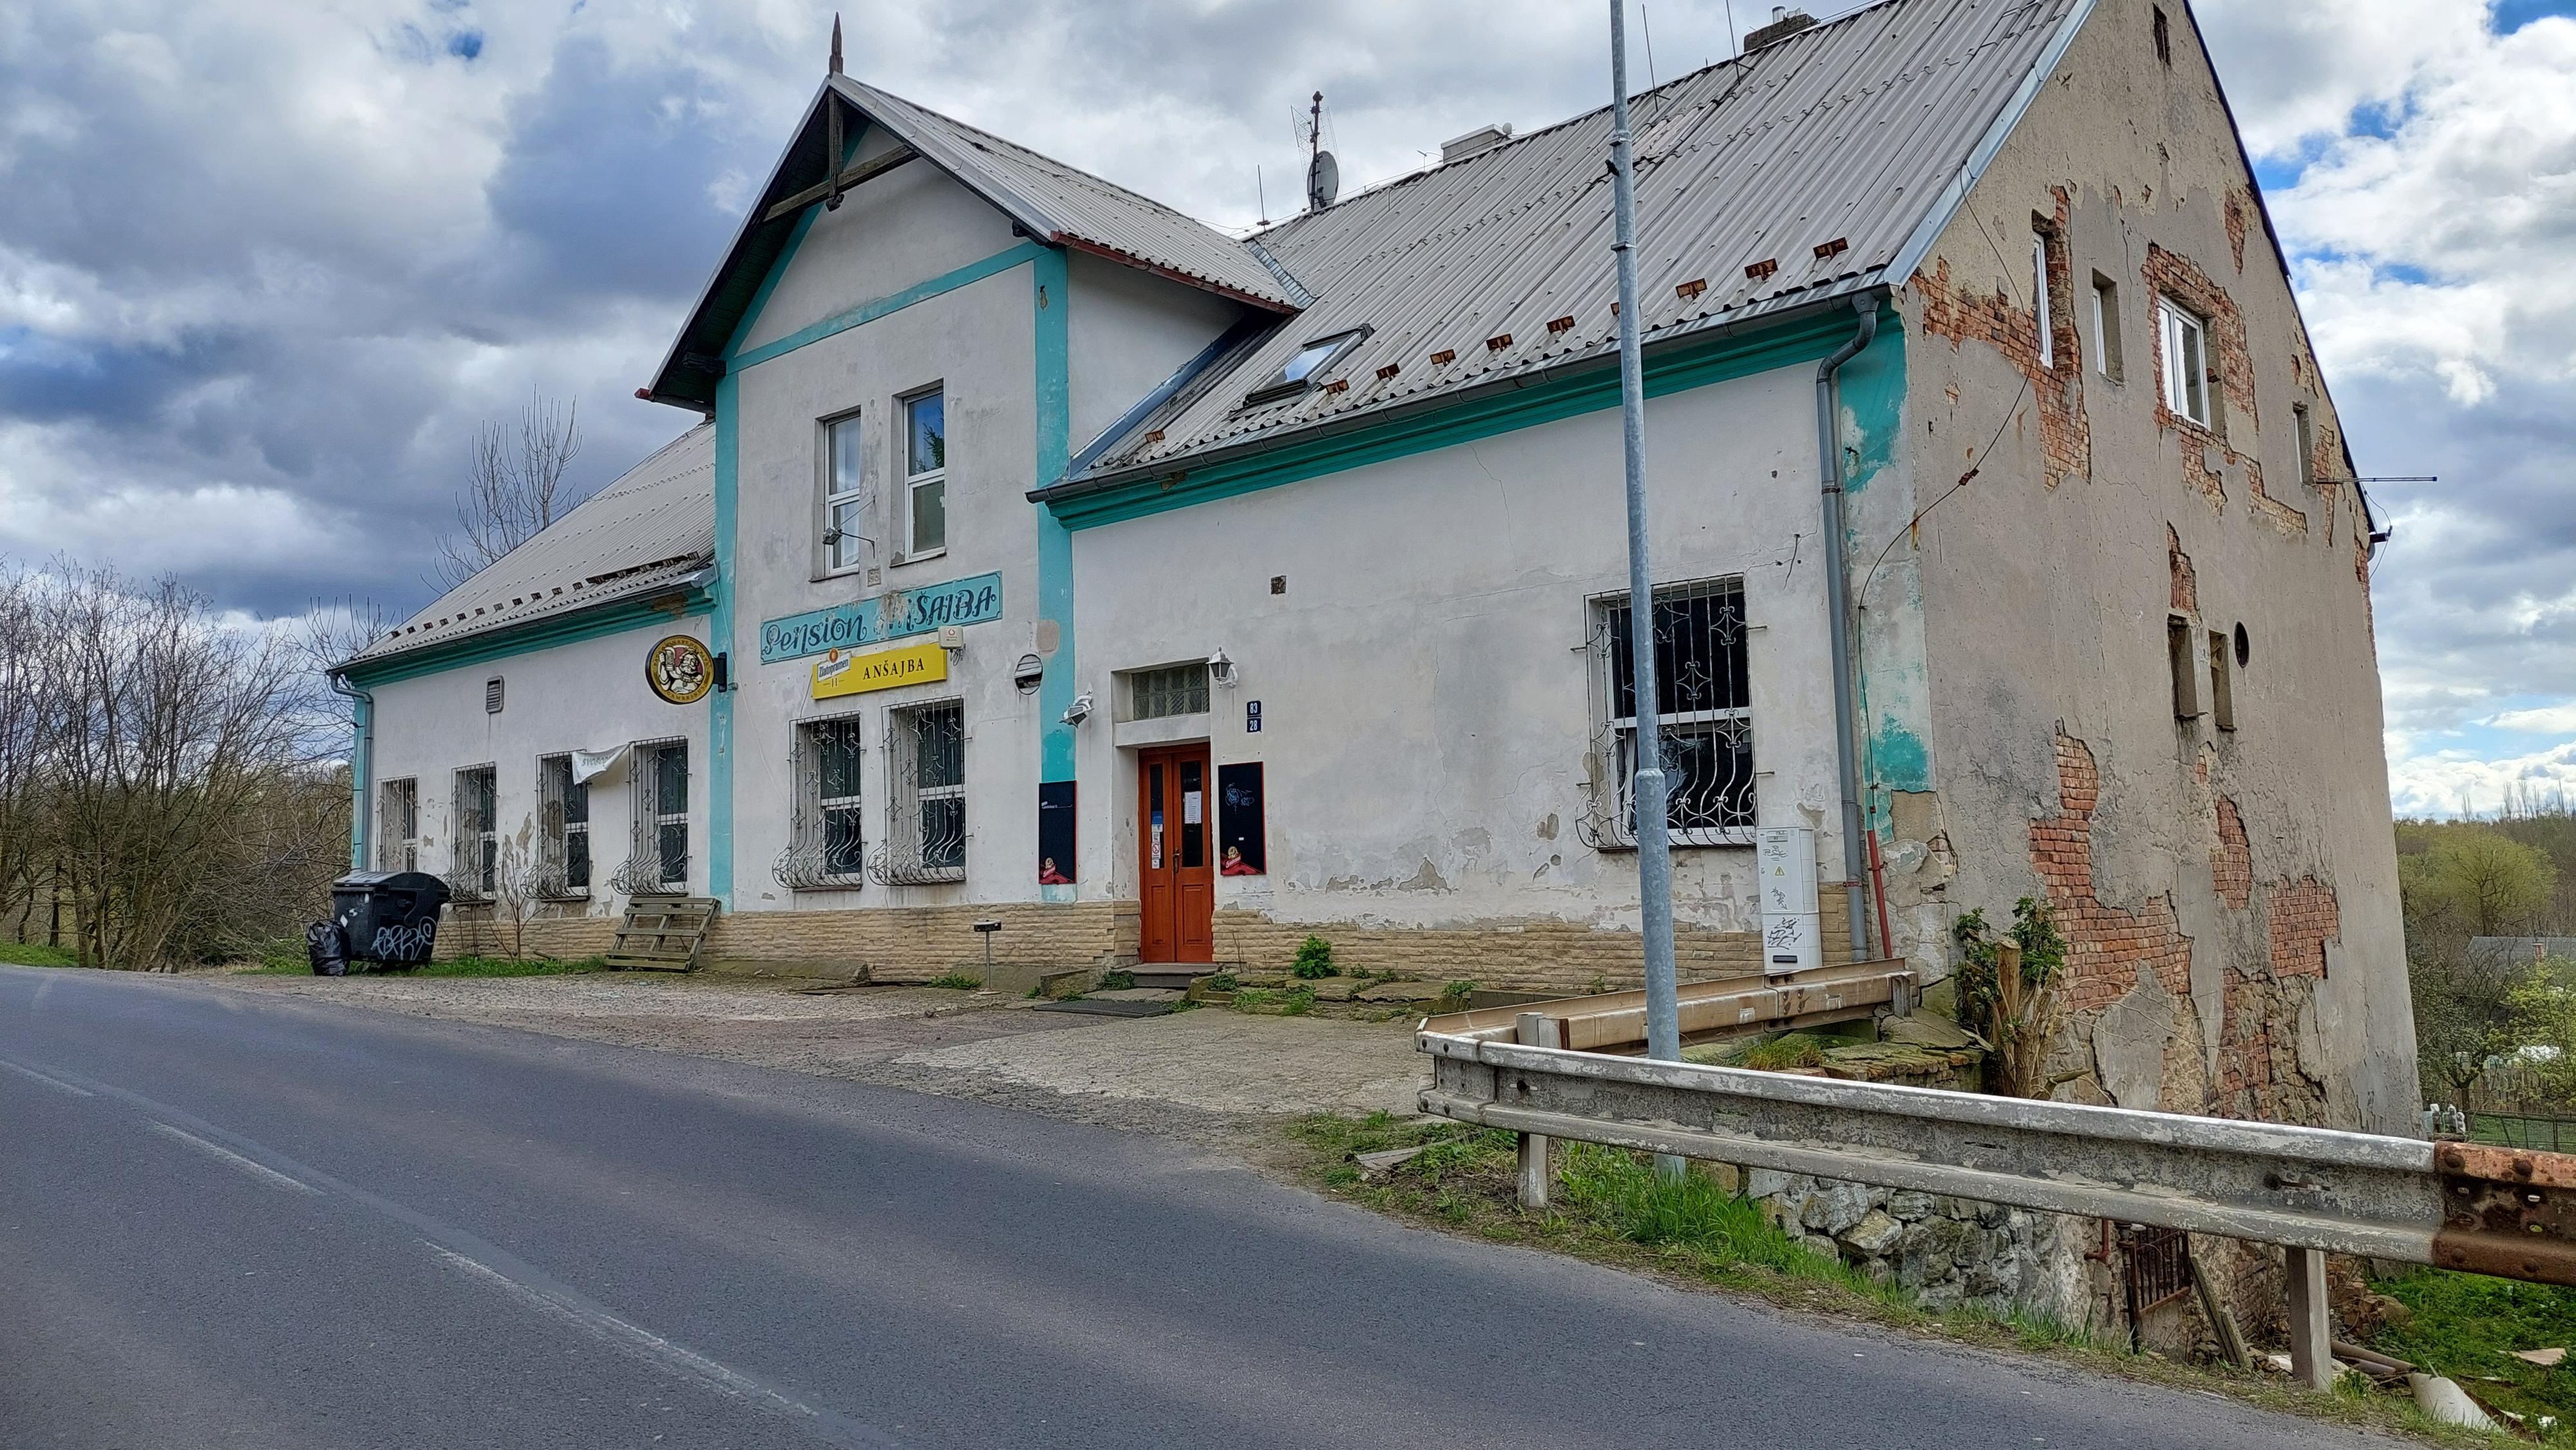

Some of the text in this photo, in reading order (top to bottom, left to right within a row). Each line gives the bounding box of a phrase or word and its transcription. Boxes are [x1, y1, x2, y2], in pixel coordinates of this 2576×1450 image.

[762, 614, 867, 655] Pension
[819, 659, 849, 677] Zlatopramen
[862, 657, 925, 680] ANŠAJBA
[1250, 702, 1257, 713] 83
[1250, 720, 1257, 731] 28
